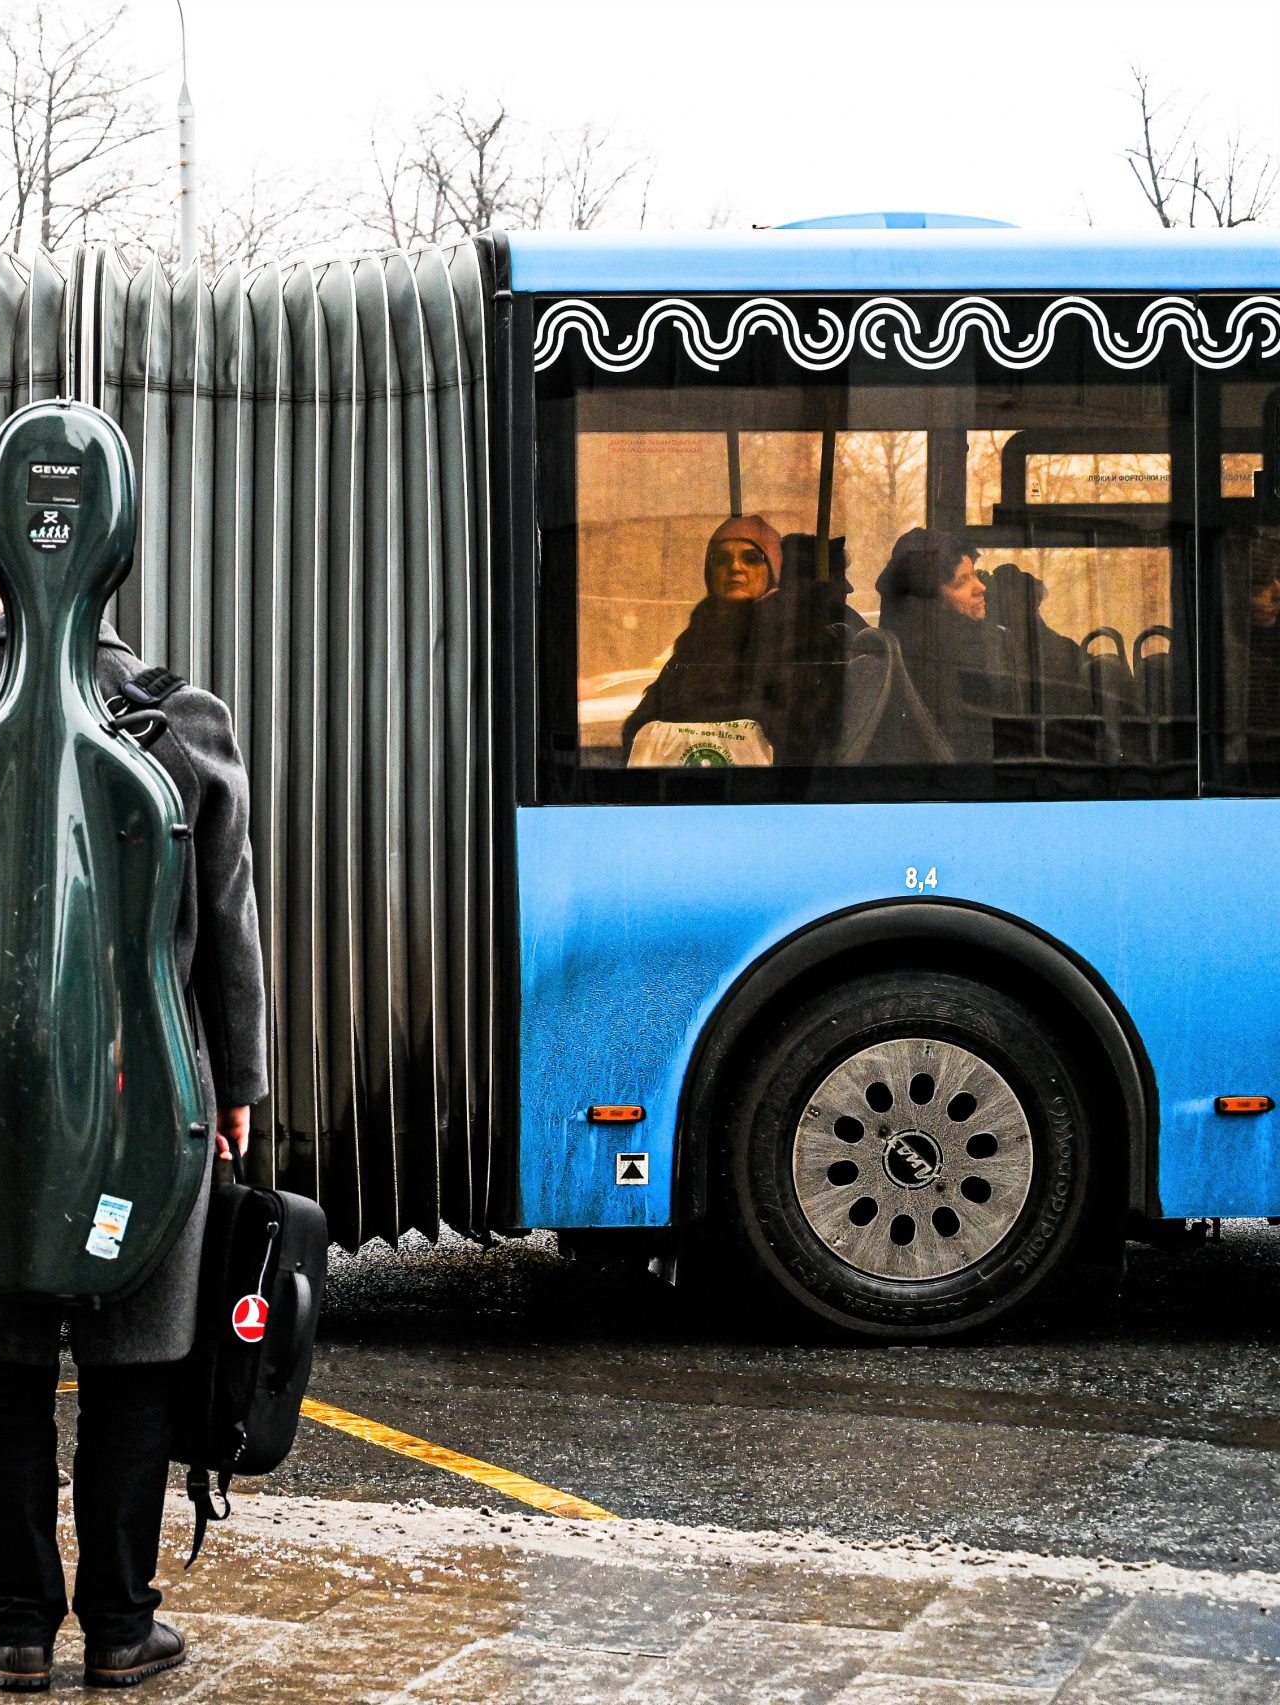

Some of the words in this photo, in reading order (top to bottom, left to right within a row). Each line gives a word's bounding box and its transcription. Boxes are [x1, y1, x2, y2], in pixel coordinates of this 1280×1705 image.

[31, 465, 81, 475] GEWA
[743, 721, 756, 730] 77
[905, 866, 938, 893] 8,4
